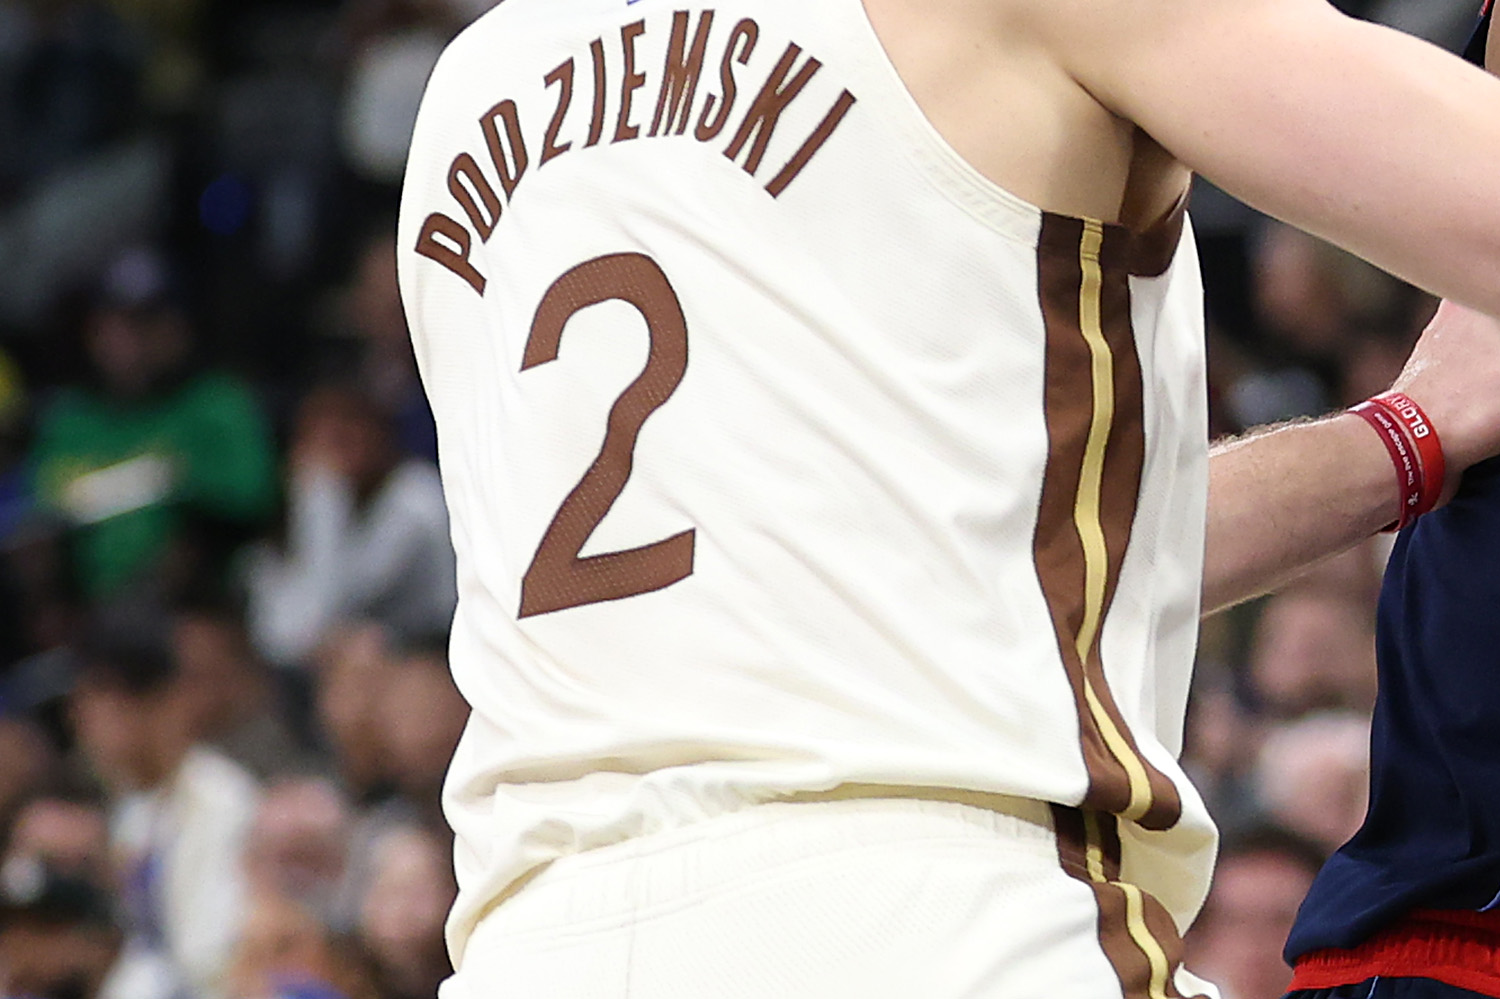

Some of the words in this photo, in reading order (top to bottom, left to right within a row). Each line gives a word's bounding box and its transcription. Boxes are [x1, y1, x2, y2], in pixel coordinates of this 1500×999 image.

[414, 8, 858, 297] PODZIEMSKI
[517, 250, 697, 620] 2
[1390, 395, 1430, 438] GLORY
